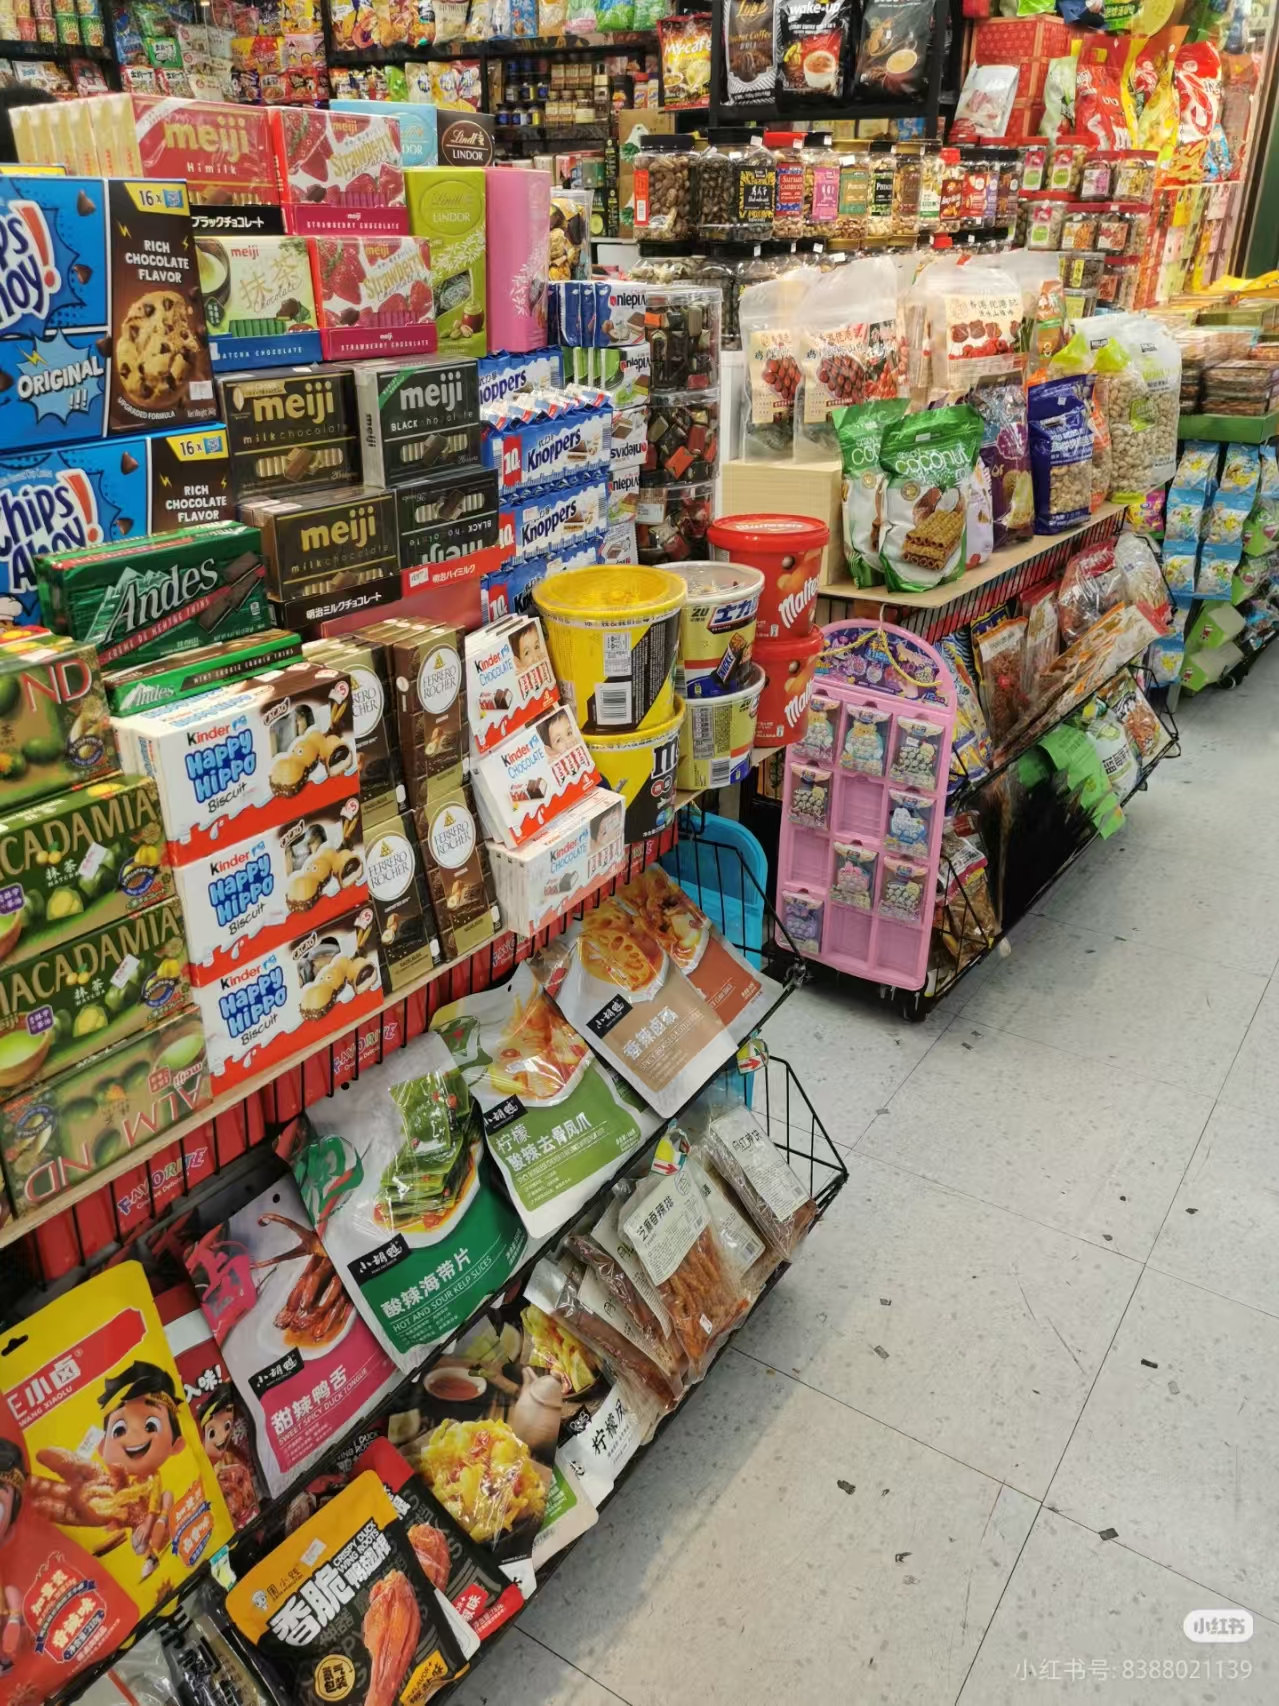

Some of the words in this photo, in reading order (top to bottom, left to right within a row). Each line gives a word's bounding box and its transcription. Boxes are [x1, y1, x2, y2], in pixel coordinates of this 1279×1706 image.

[164, 116, 249, 160] meiji
[451, 129, 478, 145] Lindt
[187, 162, 237, 174] Himilk
[452, 148, 484, 162] LINDOR
[139, 190, 155, 206] 16
[432, 211, 471, 223] LINDOR
[143, 239, 170, 254] RICH
[230, 243, 260, 260] meiji
[125, 252, 190, 270] CHOCOLATE
[138, 268, 182, 284] FLAVOR
[222, 352, 250, 360] ATCHA
[17, 357, 105, 400] ORIGINAL
[400, 370, 463, 412] meiji
[253, 381, 334, 424] meiji
[243, 431, 276, 445] milk
[390, 418, 420, 432] BLACK
[179, 439, 195, 456] 16
[527, 428, 582, 474] Knoppers
[895, 448, 972, 475] coconut
[165, 496, 228, 511] CHOCOLATE
[184, 485, 210, 496] RICH
[178, 511, 220, 523] FLAVOR
[302, 505, 377, 553] meiji
[521, 500, 578, 547] Knoppers
[291, 558, 321, 573] milk
[102, 557, 220, 646] Andes
[421, 665, 457, 687] FERRERO
[474, 651, 502, 674] Kinder
[479, 658, 513, 686] CHOCOLATE
[423, 677, 457, 700] ROCHER
[186, 723, 231, 746] Kinder
[501, 743, 531, 768] Kinder
[507, 749, 545, 779] CHOCOLATE
[207, 782, 248, 813] Biscuit
[434, 821, 469, 845] FERRERO
[437, 832, 472, 857] ROCHER
[209, 849, 251, 876] Kinder
[368, 849, 408, 877] FERRERO
[550, 838, 579, 861] Kinder
[551, 842, 588, 874] CHOCOLATE
[371, 862, 409, 889] ROCHER
[228, 902, 267, 936] Biscuit
[219, 965, 263, 991] Kinder
[240, 1012, 279, 1047] Biscuit
[495, 1123, 531, 1154] 柠檬
[505, 1111, 593, 1173] 酸辣去骨凤爪
[380, 1247, 472, 1319] 酸辣海带片
[392, 1317, 412, 1333] HOT
[412, 1306, 432, 1322] AND
[431, 1289, 454, 1310] SOUR
[453, 1275, 472, 1295] KELP
[470, 1255, 493, 1280] SLICES
[18, 1406, 44, 1428] WANG
[43, 1385, 73, 1410] XIAOLU
[270, 1364, 347, 1436] 甜辣鸭舌
[277, 1424, 303, 1446] SWEET
[302, 1407, 324, 1427] SPICY
[323, 1391, 345, 1411] DUCK
[343, 1366, 369, 1396] TONGUE
[332, 1538, 358, 1567] CRISPY
[357, 1520, 377, 1544] DUCK
[338, 1551, 359, 1574] WING
[356, 1529, 381, 1556] ROOTS
[269, 1563, 356, 1647] 香脆
